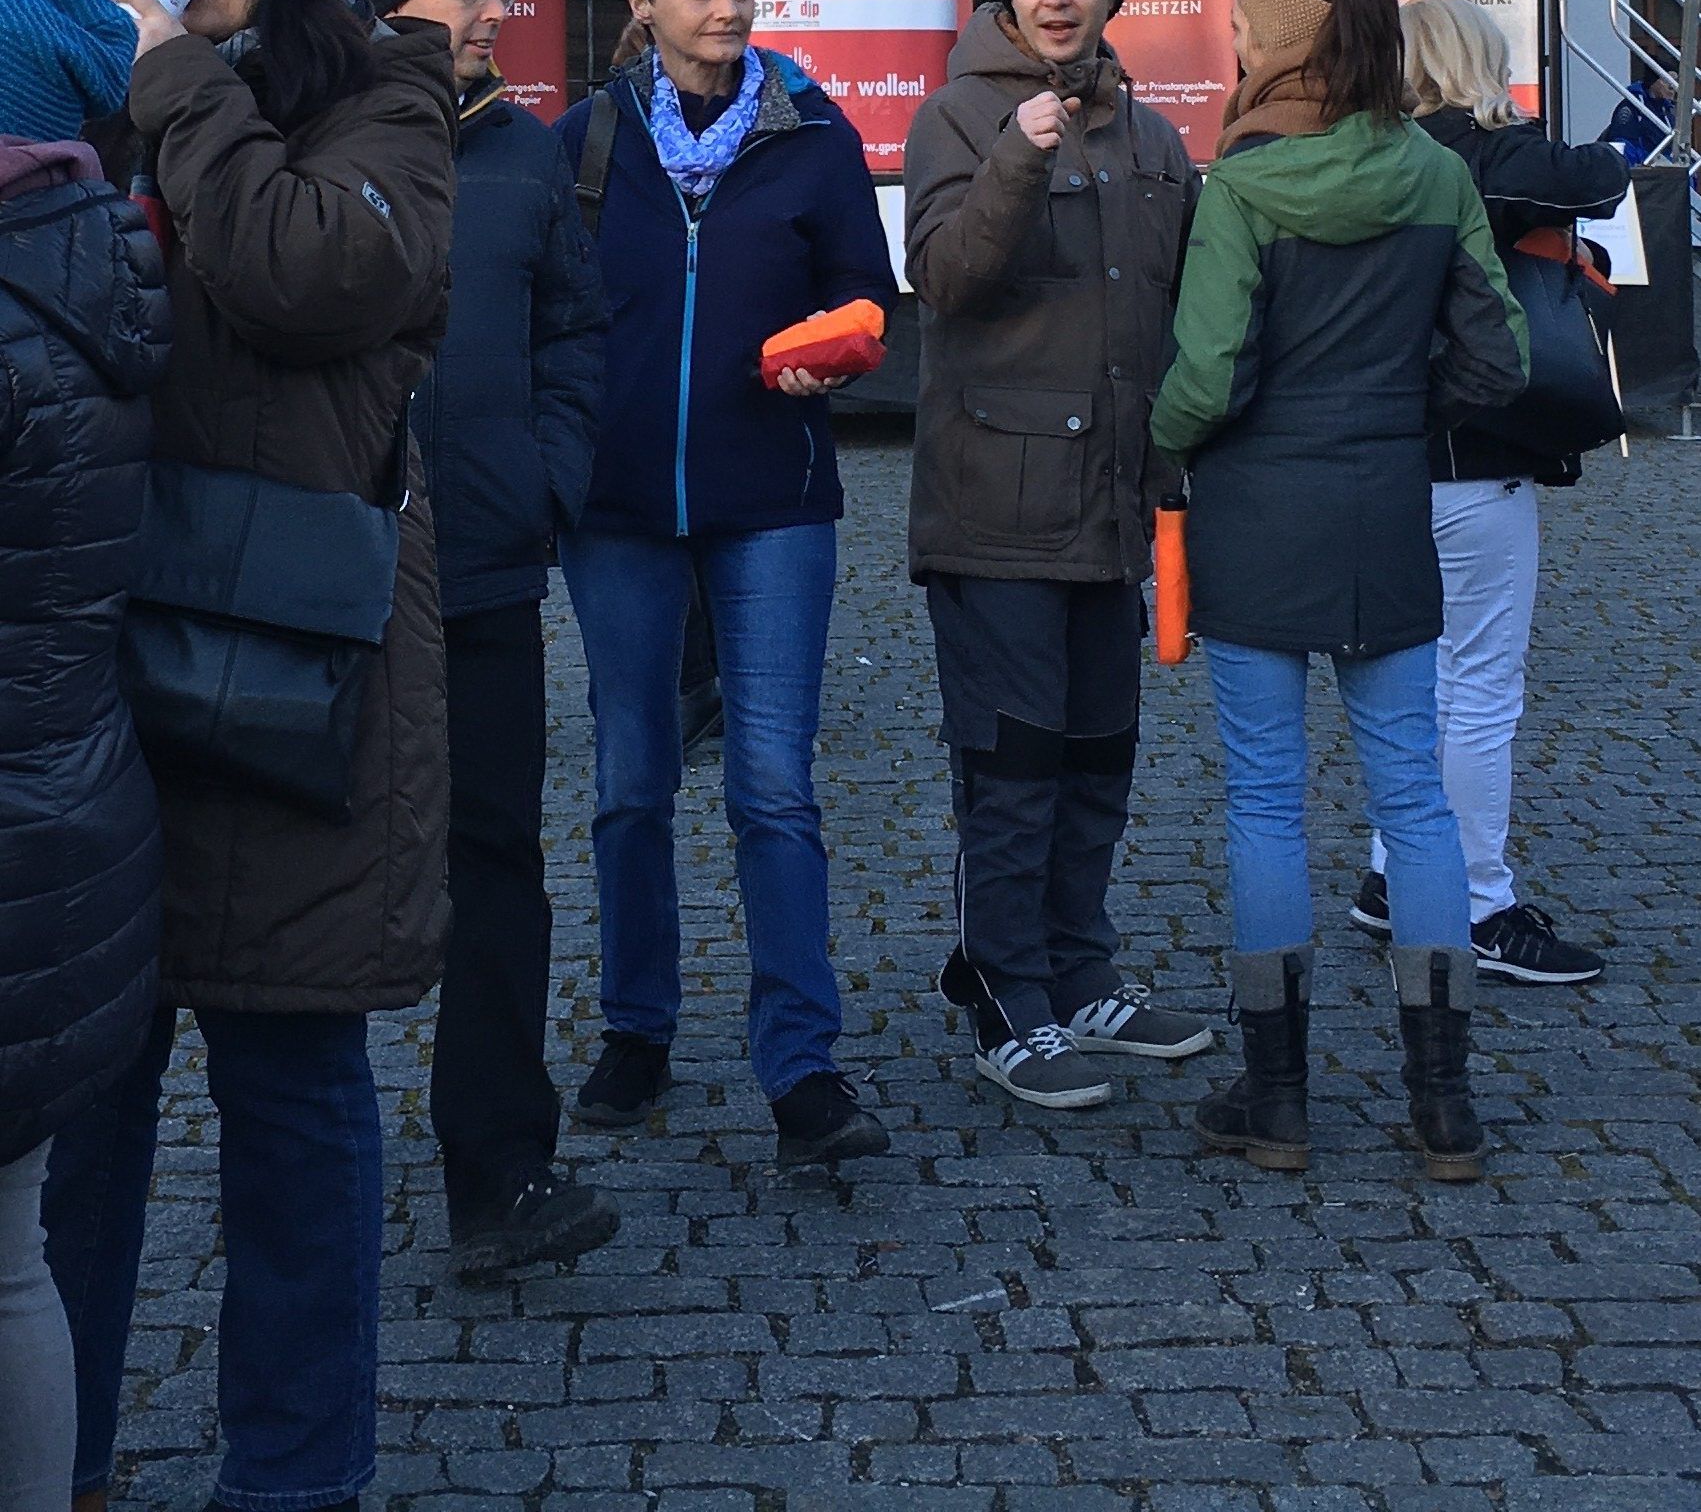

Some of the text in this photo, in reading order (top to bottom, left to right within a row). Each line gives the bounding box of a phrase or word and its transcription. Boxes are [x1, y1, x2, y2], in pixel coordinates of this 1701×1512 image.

[505, 2, 535, 17] ZEN
[800, 0, 820, 18] djp
[1119, 0, 1202, 16] CHSETZEN
[786, 46, 818, 73] lle,
[506, 81, 558, 94] angestellten,
[820, 73, 926, 96] ehr wollen!
[1132, 81, 1148, 92] der
[1149, 80, 1226, 93] Privatangestellten,
[514, 95, 542, 106] Papier
[1133, 92, 1208, 105] nalismus, Papier
[862, 138, 908, 157] w.gpa-
